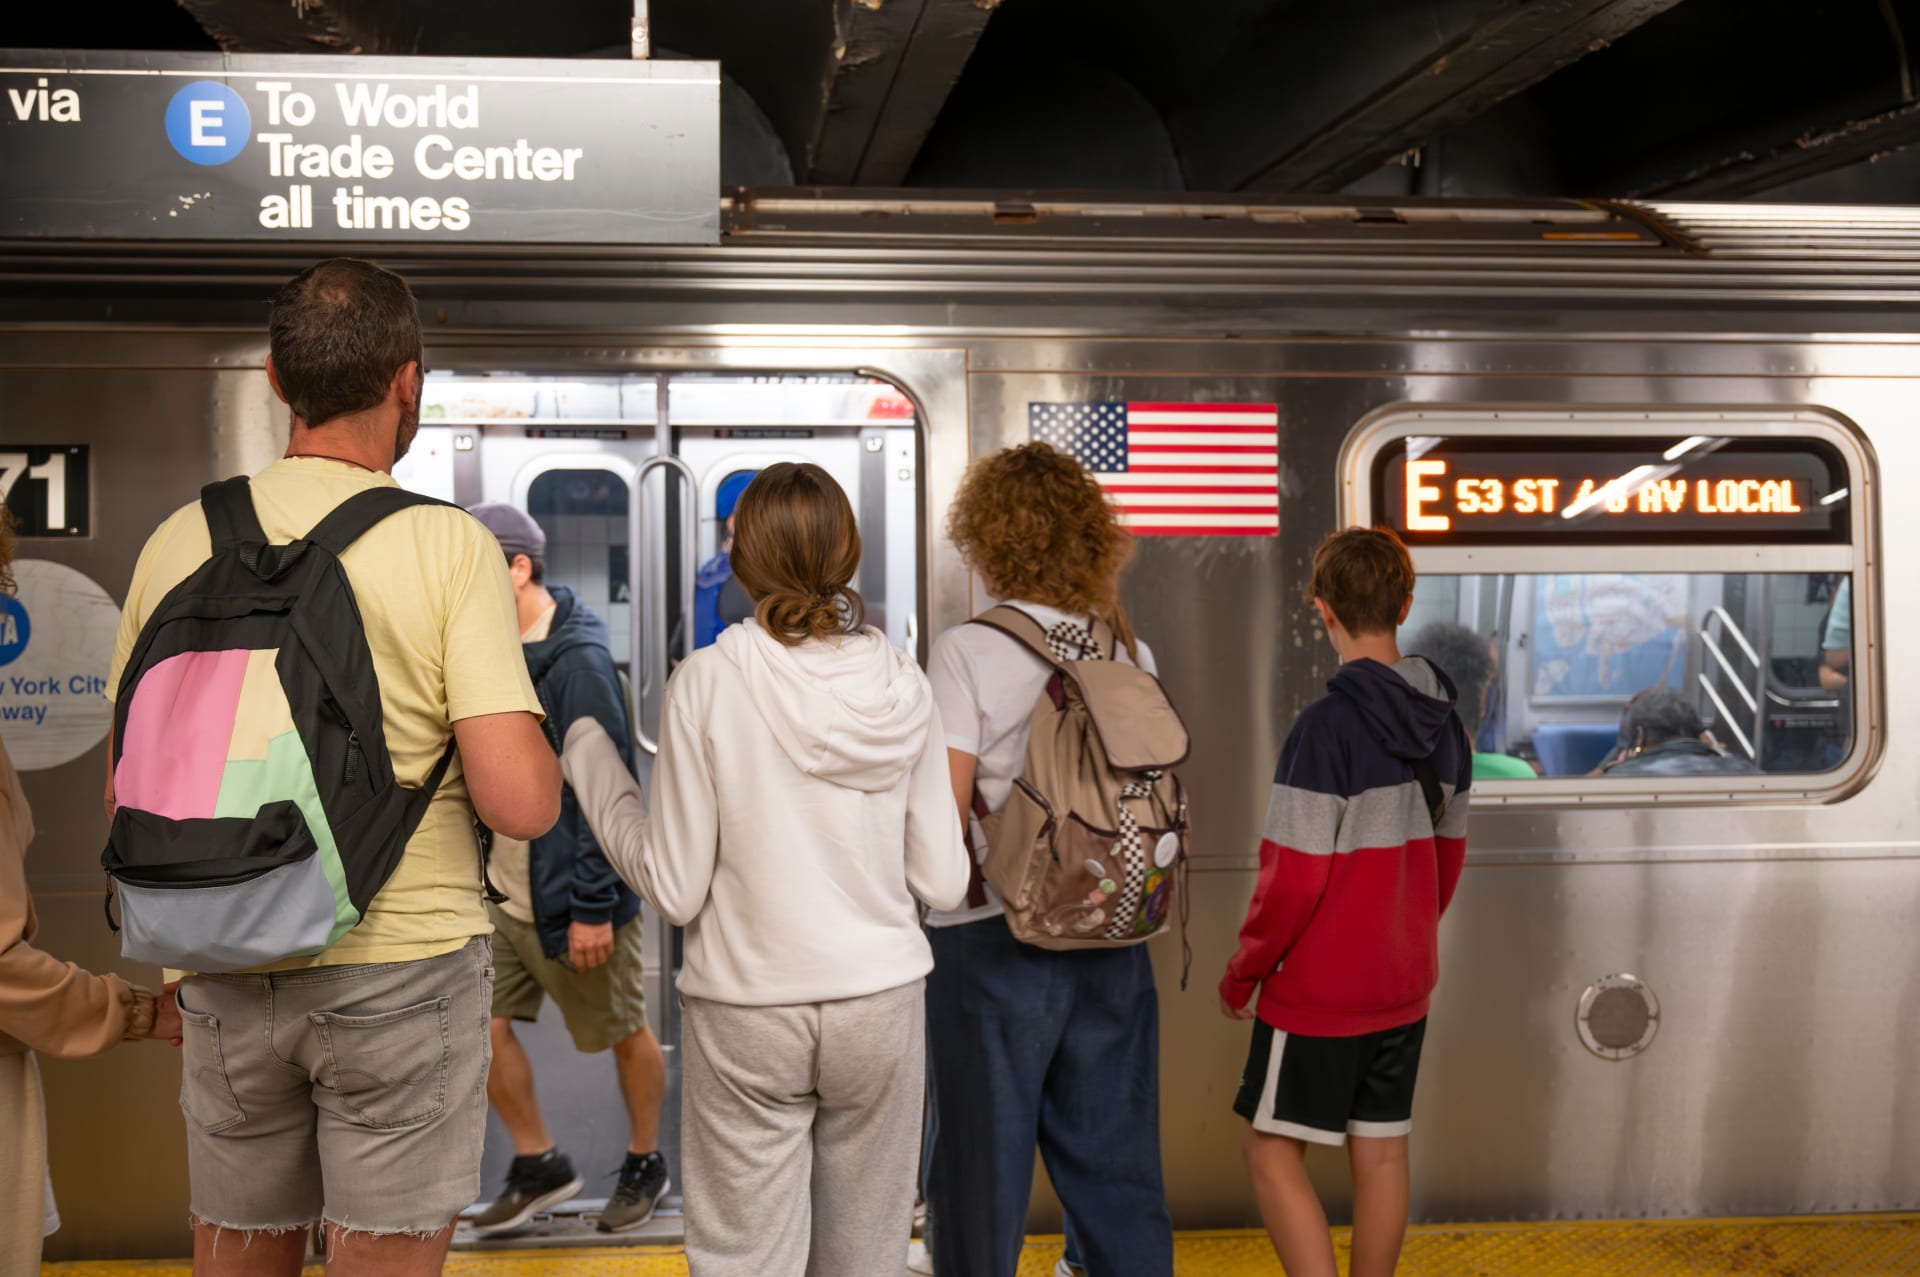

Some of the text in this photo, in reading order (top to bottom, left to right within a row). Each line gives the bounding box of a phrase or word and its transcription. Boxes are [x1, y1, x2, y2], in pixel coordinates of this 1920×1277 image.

[8, 78, 81, 122] via
[190, 100, 227, 147] E
[255, 81, 480, 129] To World
[256, 132, 583, 181] Trade Center
[258, 184, 471, 231] all times
[1405, 460, 1451, 531] E
[1456, 478, 1504, 513] 53
[1512, 478, 1559, 513] ST
[1637, 478, 1688, 513] AV
[1696, 478, 1801, 513] LOCAL
[10, 676, 61, 696] York
[0, 705, 47, 725] way
